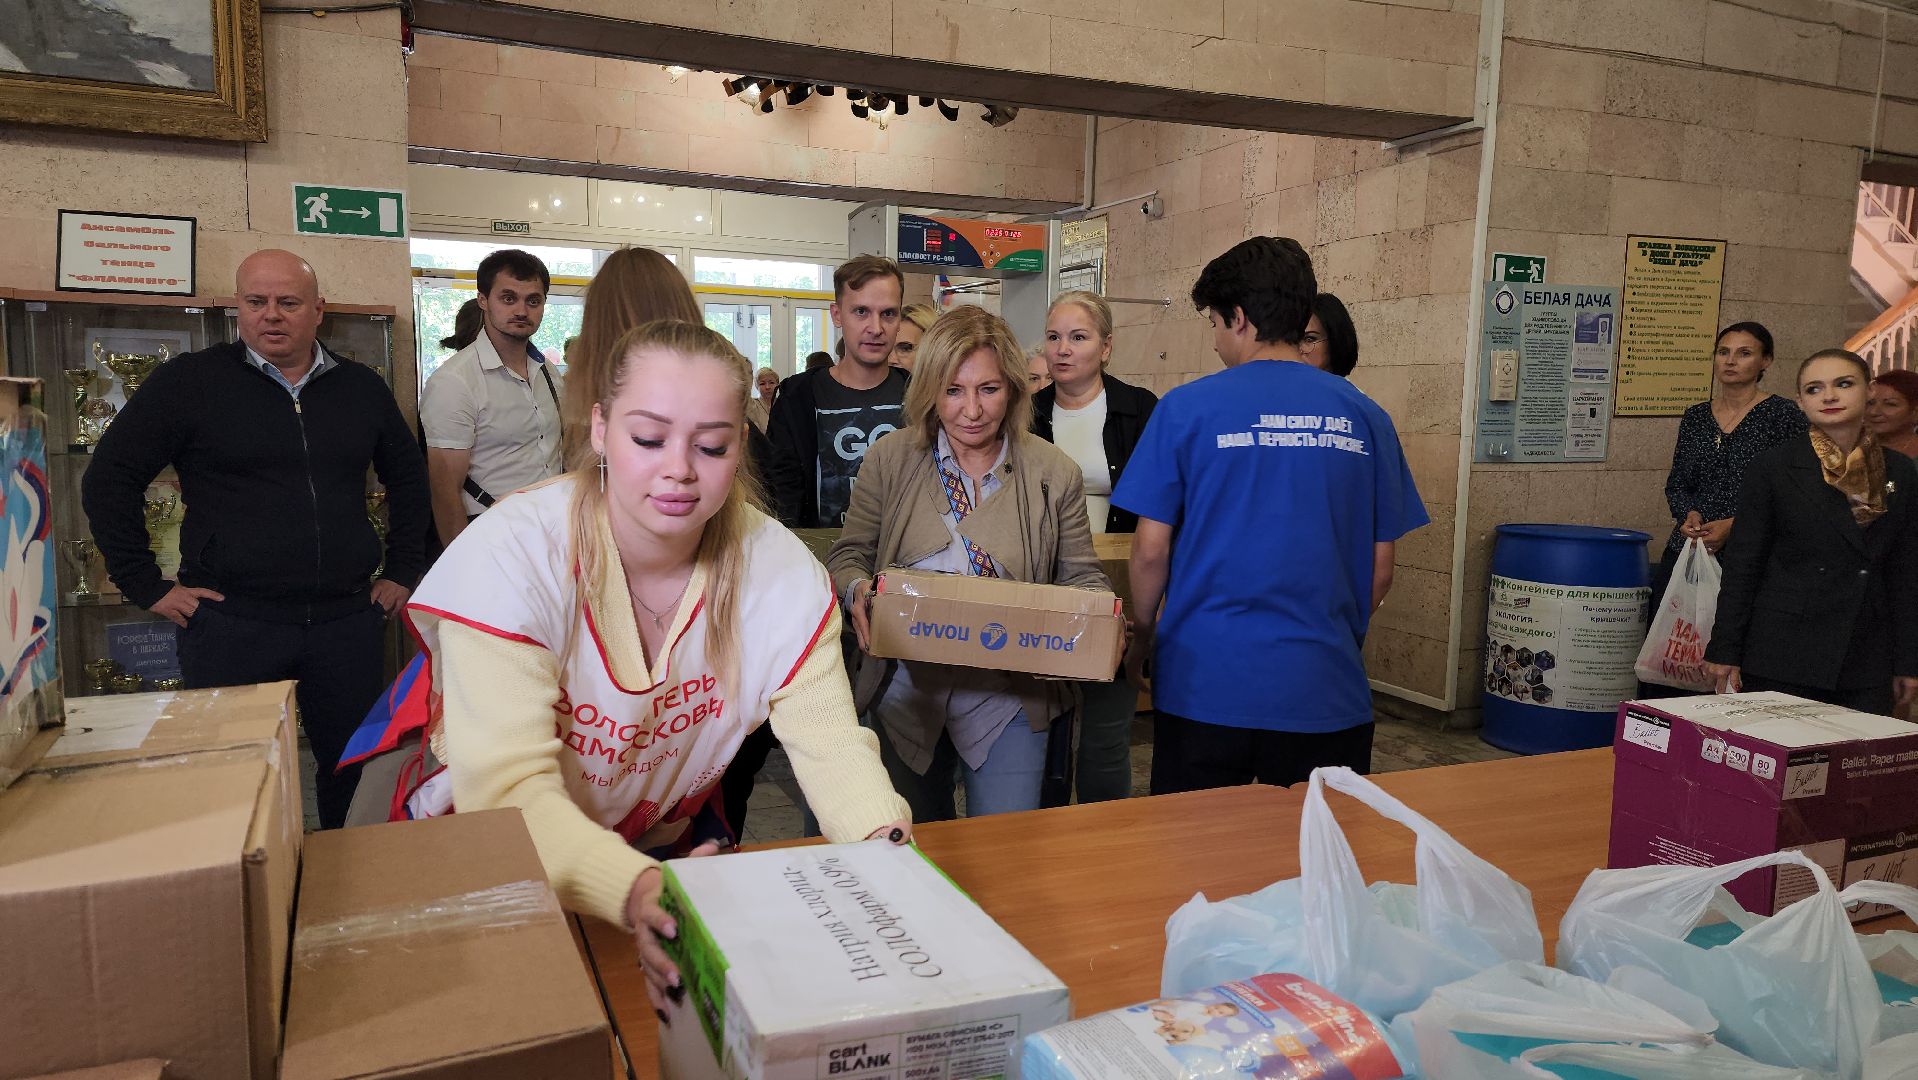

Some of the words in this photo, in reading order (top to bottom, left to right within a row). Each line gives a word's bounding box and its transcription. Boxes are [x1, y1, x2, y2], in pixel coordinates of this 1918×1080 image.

[495, 222, 528, 232] ВЫХОД
[1524, 291, 1571, 306] БЕЛАЯ
[1575, 292, 1613, 309] ДАЧА
[1287, 416, 1322, 429] СИЛУ
[1217, 432, 1255, 448] НАША
[1259, 432, 1317, 447] ВЕРНОСТЬ
[1506, 582, 1563, 598] Контейнер
[1567, 590, 1589, 599] для
[1593, 591, 1635, 601] крышек
[1019, 633, 1074, 652] POLAR
[1706, 743, 1719, 754] A4
[1757, 760, 1770, 771] 80
[1870, 752, 1894, 767] Paper
[581, 771, 613, 787] МЫ
[1850, 839, 1894, 853] INTERNATIONAL
[824, 920, 887, 981] Натрия
[830, 1043, 867, 1060] cart
[828, 1053, 891, 1074] BLANK
